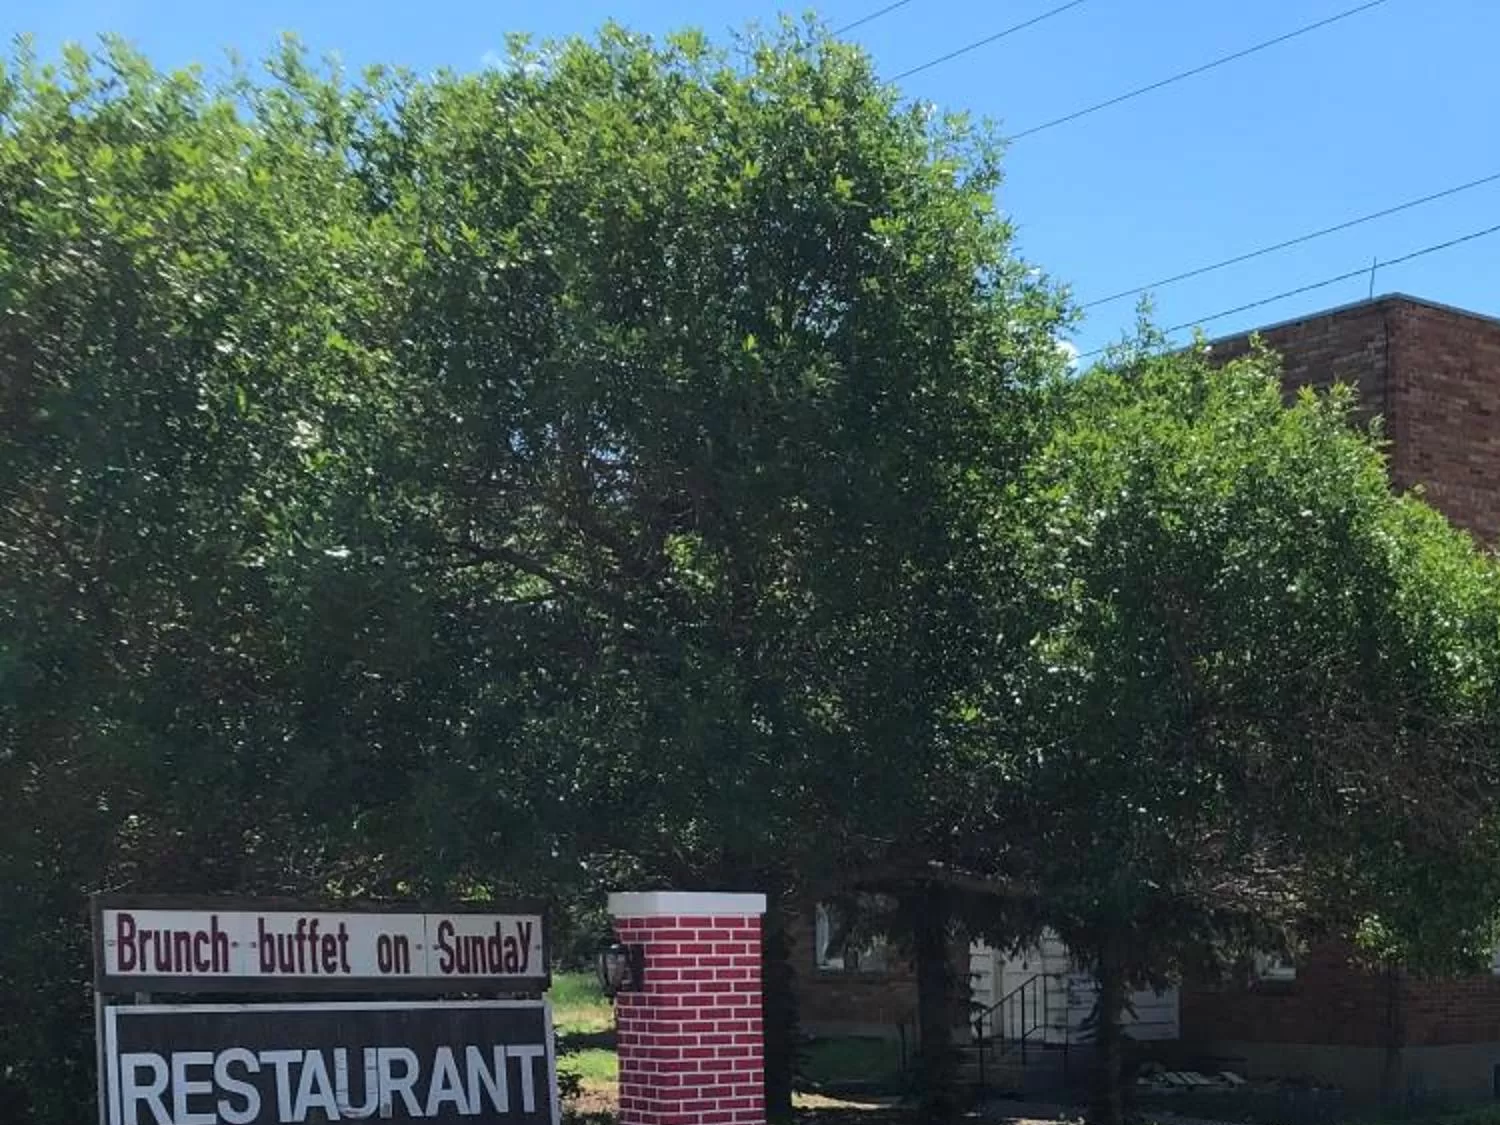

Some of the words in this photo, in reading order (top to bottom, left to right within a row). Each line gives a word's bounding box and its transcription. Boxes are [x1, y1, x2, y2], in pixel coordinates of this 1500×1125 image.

[115, 912, 230, 974] Brunch
[257, 916, 351, 974] buffet
[376, 930, 411, 974] on
[437, 919, 533, 975] Sunday
